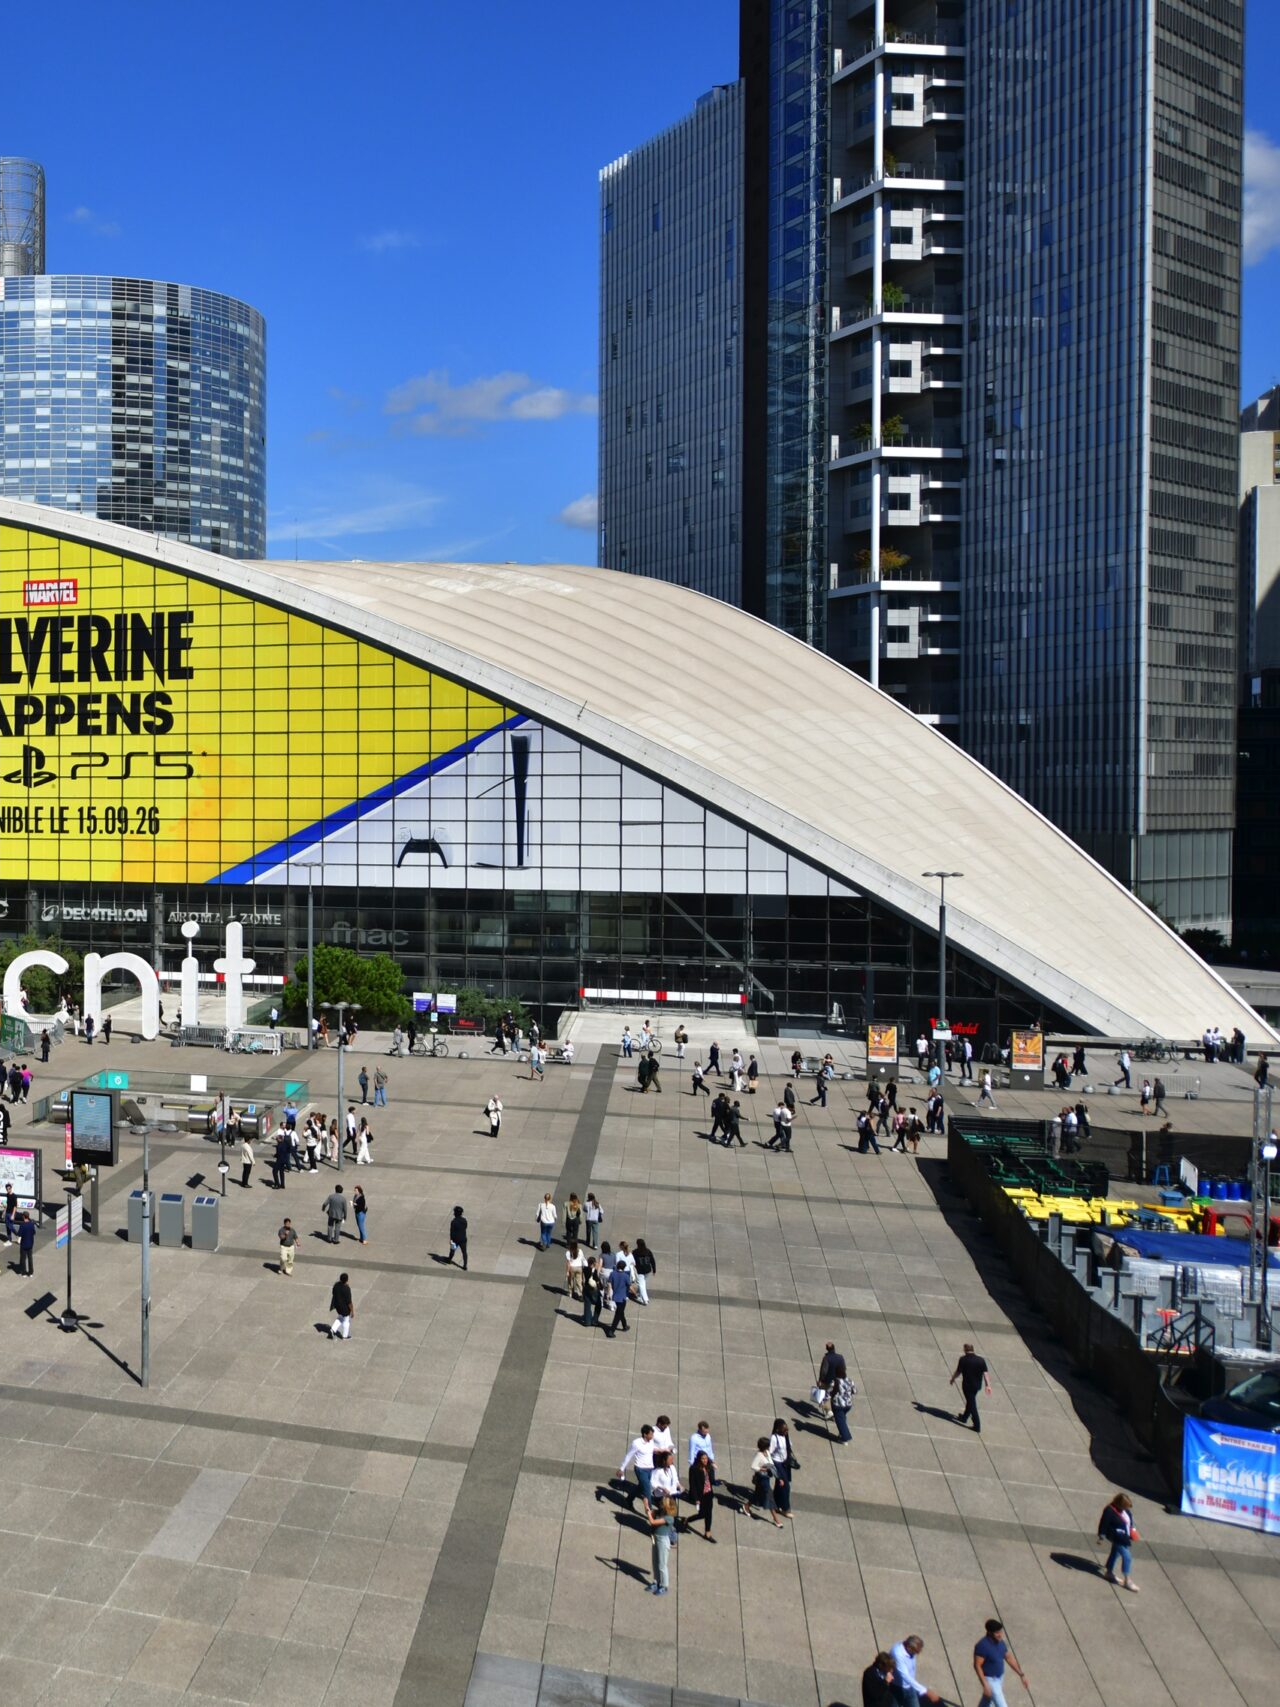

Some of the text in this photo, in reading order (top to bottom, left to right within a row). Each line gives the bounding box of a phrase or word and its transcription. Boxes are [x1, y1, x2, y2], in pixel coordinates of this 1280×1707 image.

[25, 581, 76, 604] MARVEL
[70, 751, 194, 780] PS5
[50, 806, 70, 833] LE
[77, 806, 160, 834] 15.09.26
[62, 907, 148, 923] DECATHLON
[330, 921, 410, 946] fnac
[3, 920, 257, 1041] cnit
